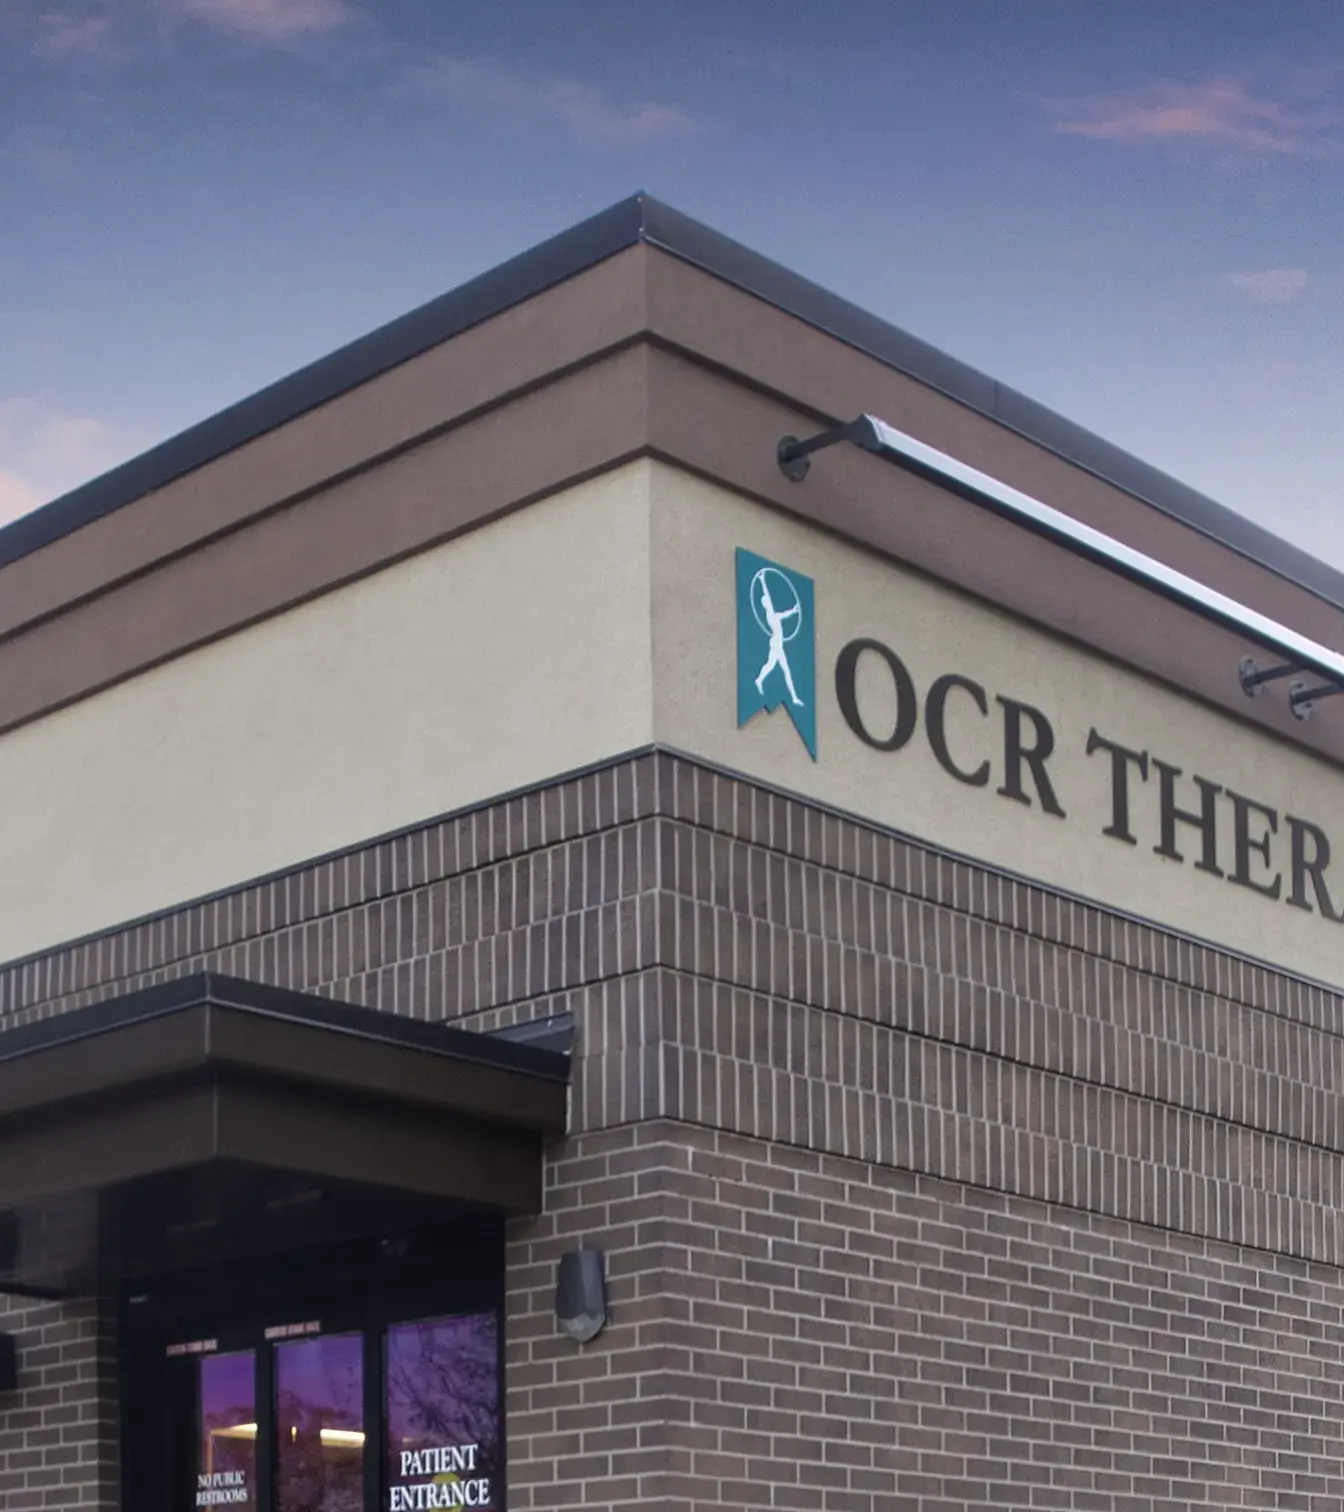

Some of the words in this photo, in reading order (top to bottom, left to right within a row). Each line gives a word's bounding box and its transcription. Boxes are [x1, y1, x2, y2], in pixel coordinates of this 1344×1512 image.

[834, 637, 1066, 819] OCR
[400, 1444, 478, 1476] PATIENT
[198, 1473, 212, 1488] NO
[213, 1470, 245, 1487] PUBLIC
[389, 1478, 490, 1512] ENTRANCE
[195, 1488, 248, 1506] RESTROOMS
